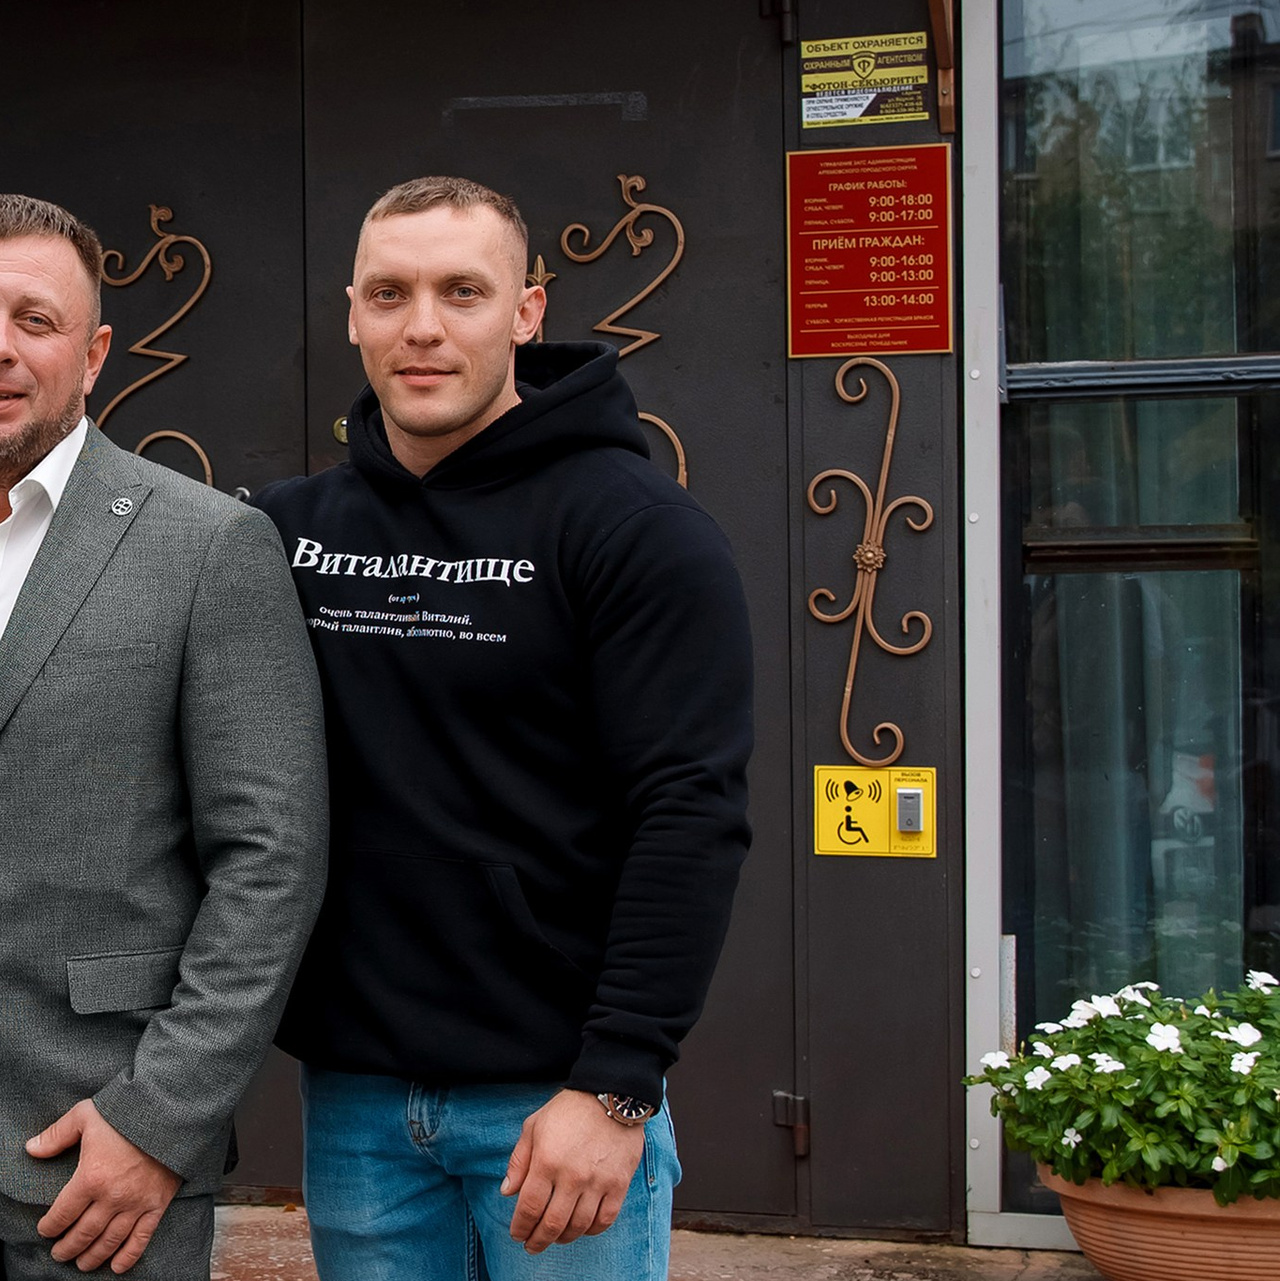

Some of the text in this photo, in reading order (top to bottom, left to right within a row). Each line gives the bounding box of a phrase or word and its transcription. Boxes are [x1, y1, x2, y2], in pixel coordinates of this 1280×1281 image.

[806, 35, 924, 54] ОБЪЕКТ ОХРАНЯЕТСЯ
[803, 53, 924, 70] ОХРАННЫМ АГЕНТСТВОМ
[828, 179, 907, 191] ГРАФИК РАБОТЫ:
[869, 193, 933, 207] 9:00-18:00
[869, 209, 933, 222] 9:00-17:00
[812, 234, 925, 250] ПРИЁМ ГРАЖДАН:
[869, 254, 933, 267] 9:00-16:00
[869, 269, 934, 282] 9:00-13:00
[863, 293, 934, 307] 13:00-14:00
[291, 537, 535, 587] Виталантище
[319, 606, 472, 626] очень талантливый Виталий.
[341, 623, 405, 638] талантлив,
[406, 626, 456, 640] абсолютно,
[459, 631, 474, 640] во
[476, 632, 507, 642] всем
